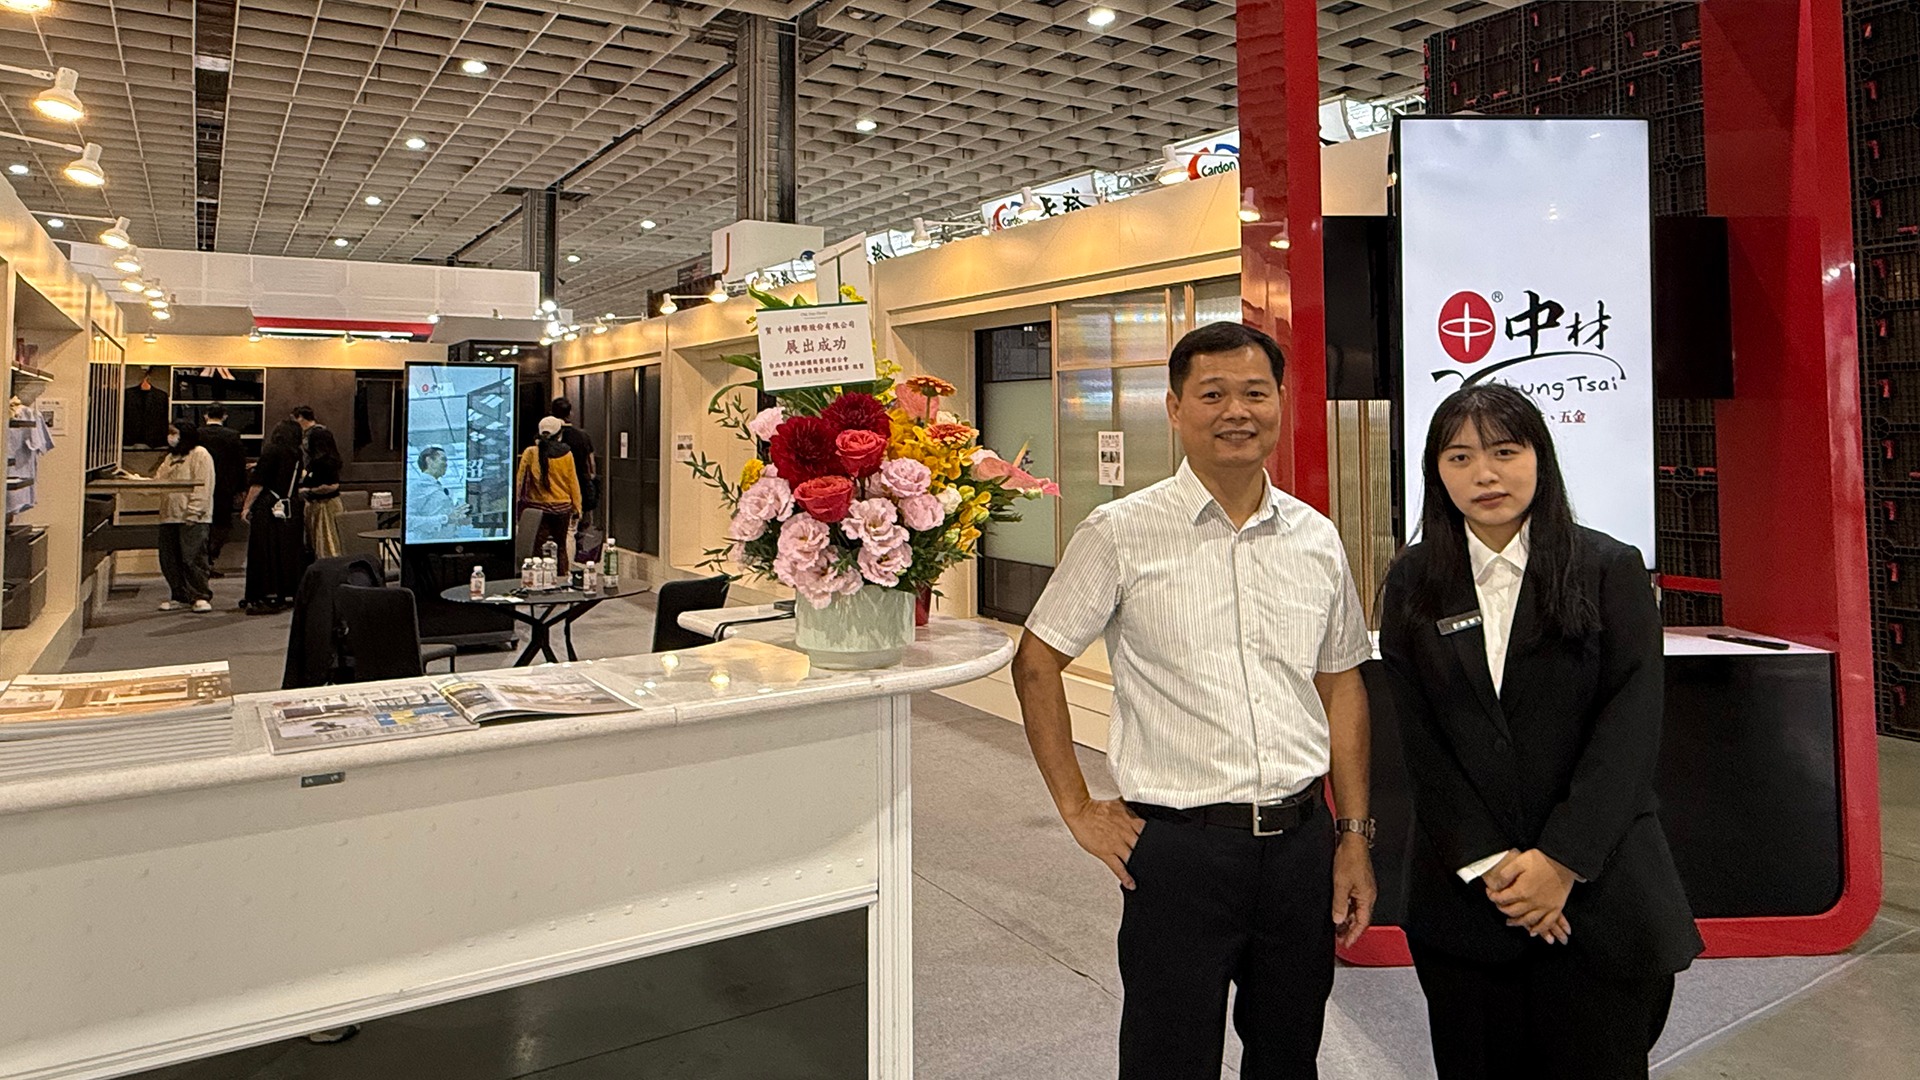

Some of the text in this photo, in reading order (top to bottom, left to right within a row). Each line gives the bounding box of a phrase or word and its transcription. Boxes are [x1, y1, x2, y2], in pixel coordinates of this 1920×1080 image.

[1201, 161, 1237, 177] Cardon
[1505, 290, 1612, 355] 中材
[785, 336, 847, 355] 展出成功
[1490, 375, 1618, 401] ung Tsai
